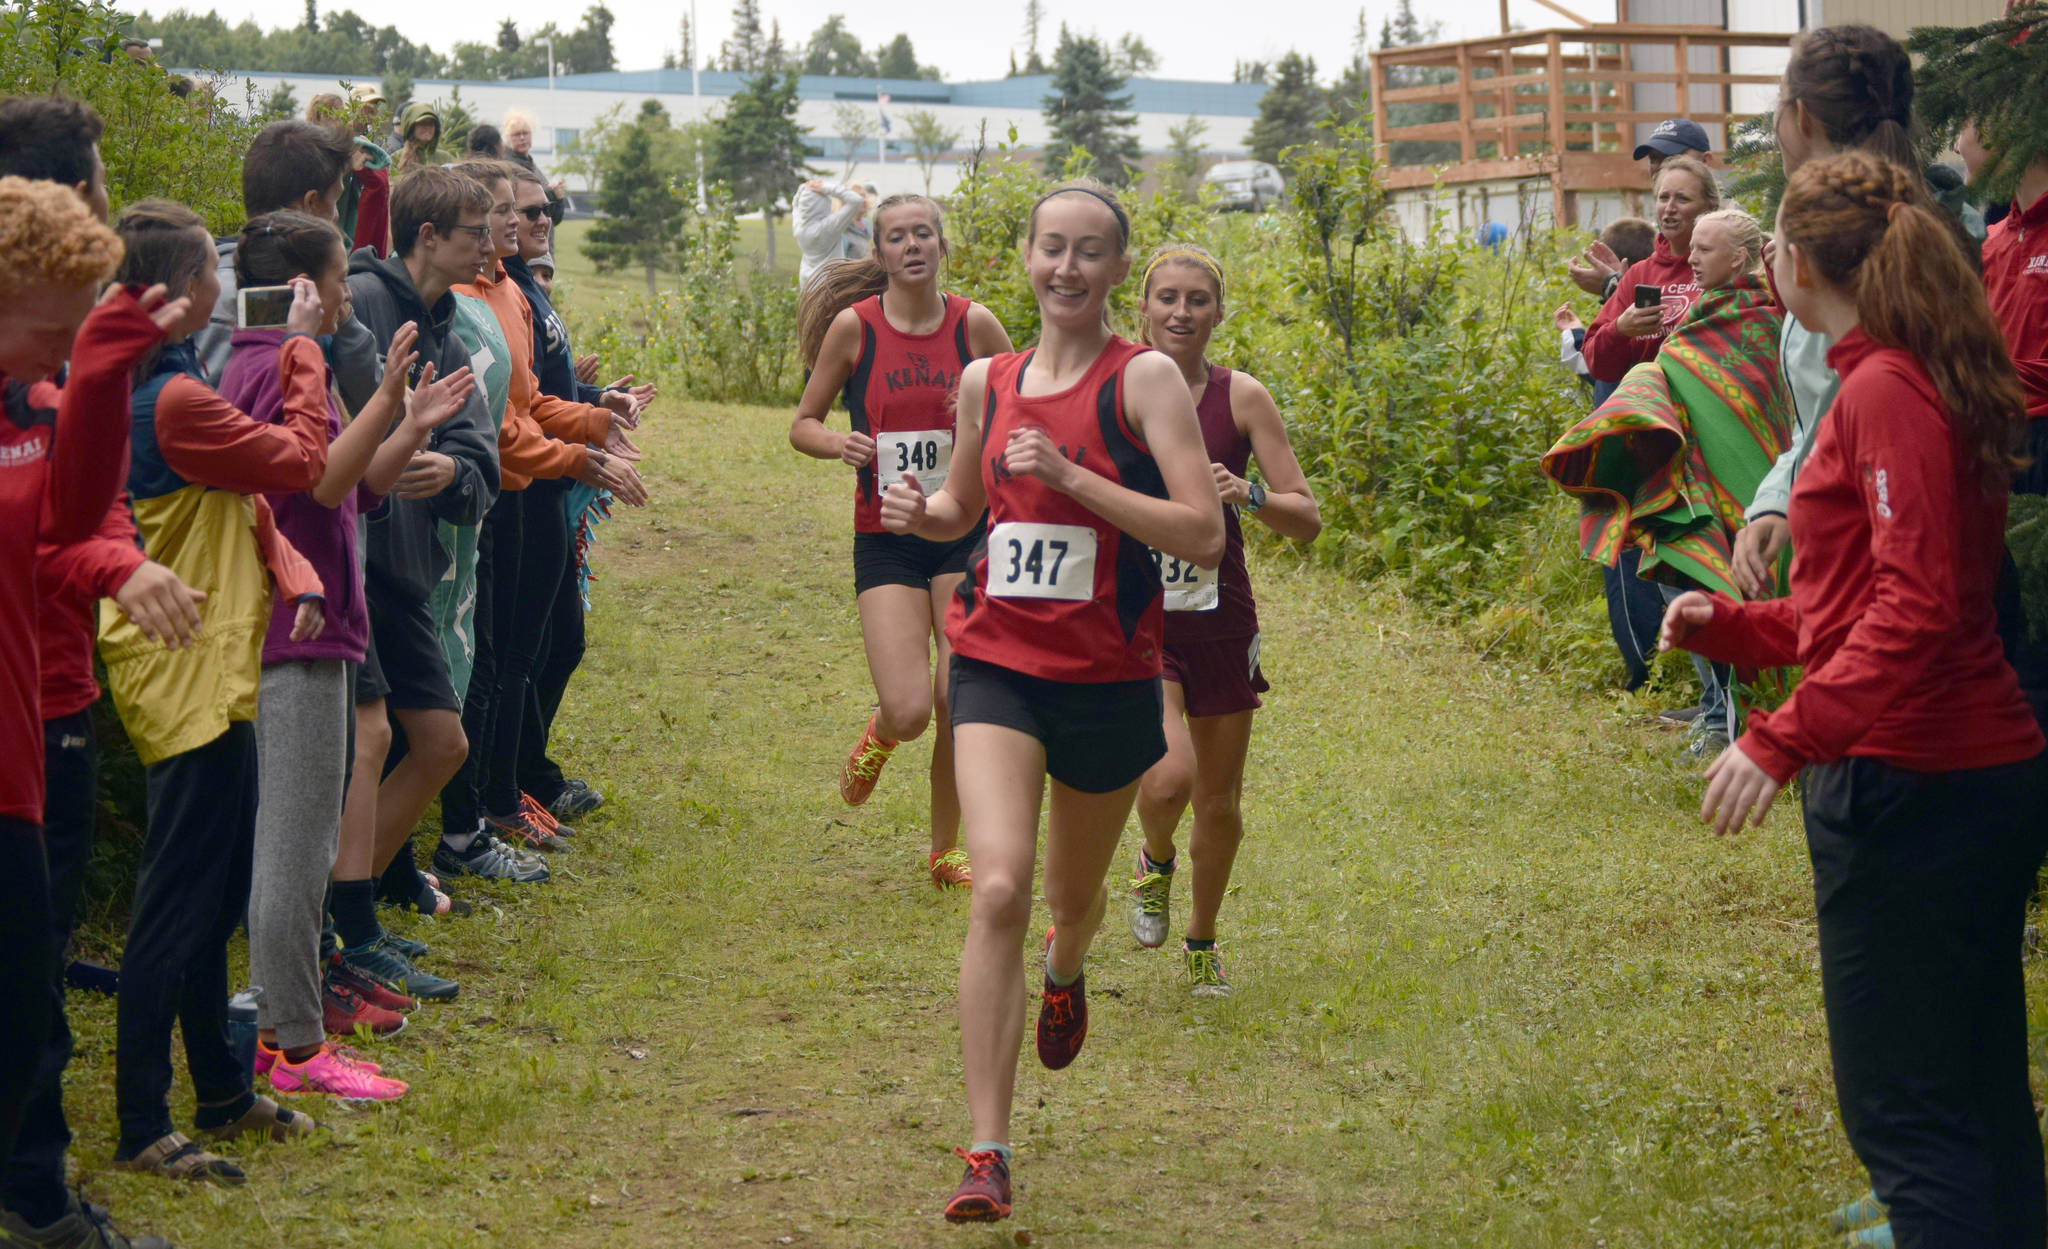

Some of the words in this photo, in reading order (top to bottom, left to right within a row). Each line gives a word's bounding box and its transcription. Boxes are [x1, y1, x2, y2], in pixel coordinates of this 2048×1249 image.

[885, 367, 955, 394] KENAI
[0, 436, 41, 460] ENAI
[895, 440, 938, 472] 348
[1006, 538, 1068, 586] 347
